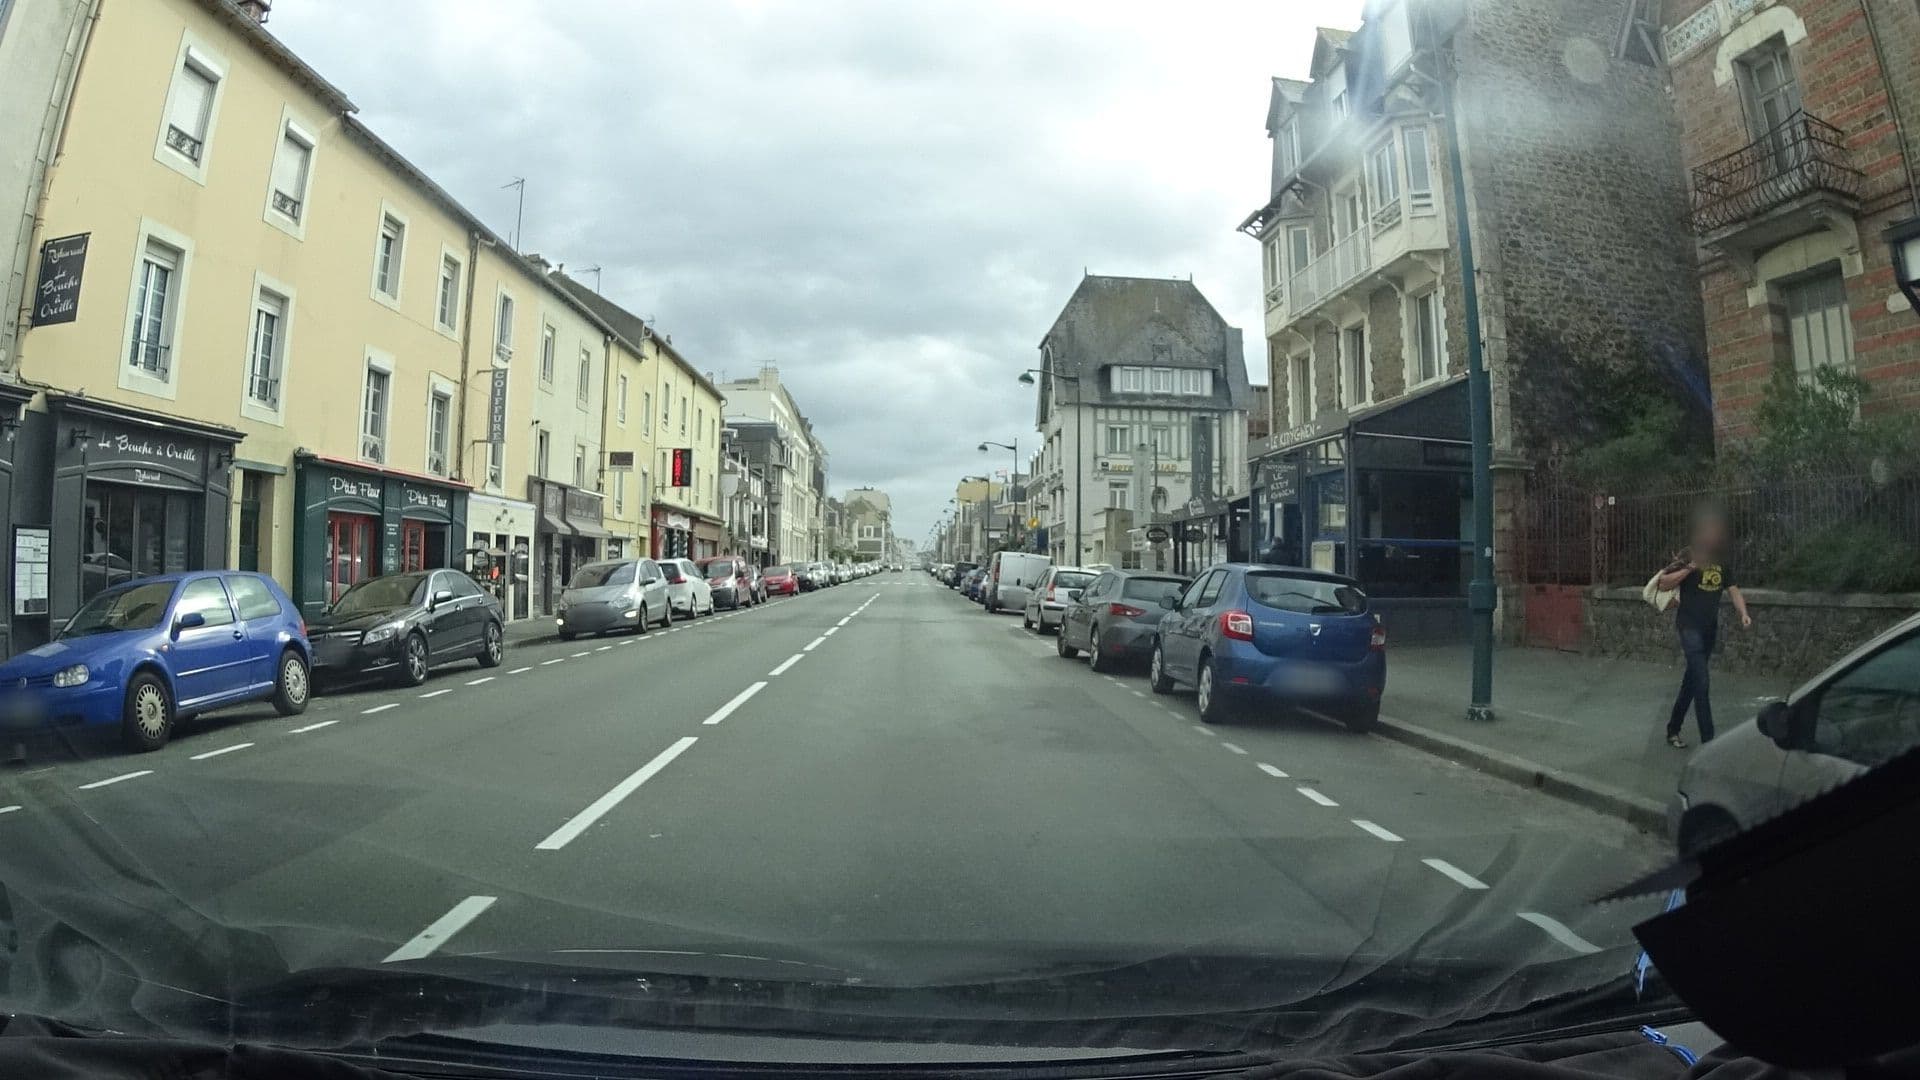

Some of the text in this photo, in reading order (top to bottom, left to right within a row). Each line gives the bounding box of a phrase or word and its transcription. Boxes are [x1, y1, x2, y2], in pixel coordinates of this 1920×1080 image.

[494, 371, 505, 440] COIFFURE
[98, 431, 111, 449] Le
[115, 434, 153, 455] Bouche
[166, 443, 196, 461] Oreille
[358, 482, 381, 498] Fleur
